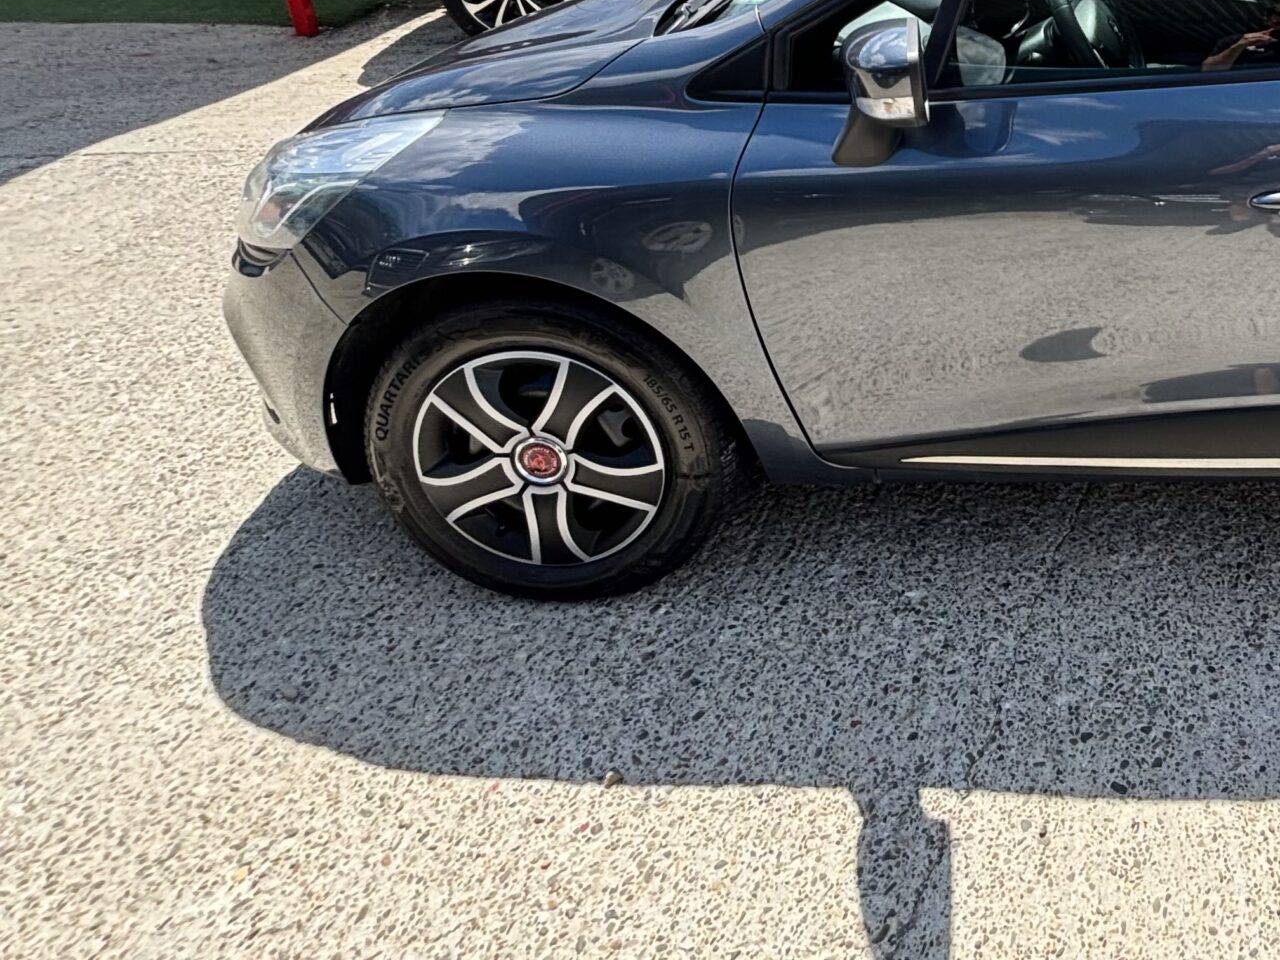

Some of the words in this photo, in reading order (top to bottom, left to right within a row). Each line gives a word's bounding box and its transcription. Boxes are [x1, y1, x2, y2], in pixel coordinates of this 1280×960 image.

[643, 375, 678, 413] 185/65
[672, 414, 683, 425] R
[678, 425, 691, 440] 15
[684, 442, 695, 451] T
